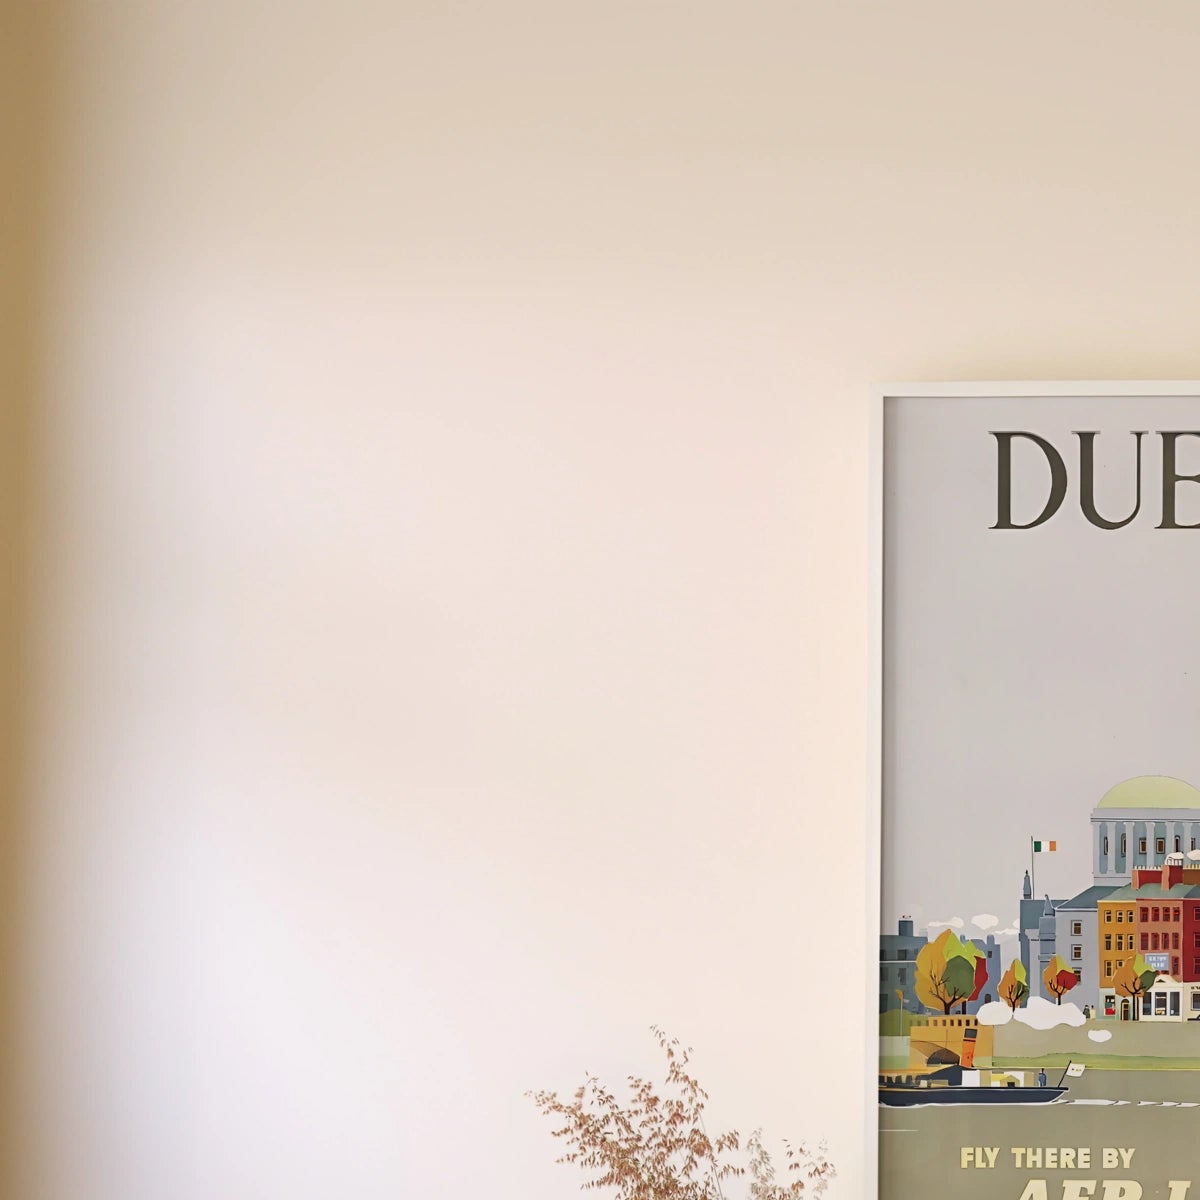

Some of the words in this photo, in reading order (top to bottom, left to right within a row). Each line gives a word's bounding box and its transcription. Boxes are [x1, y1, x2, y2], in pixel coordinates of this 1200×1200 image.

[960, 1147, 1000, 1169] FLY
[1011, 1147, 1091, 1169] THERE
[1103, 1147, 1135, 1169] BY
